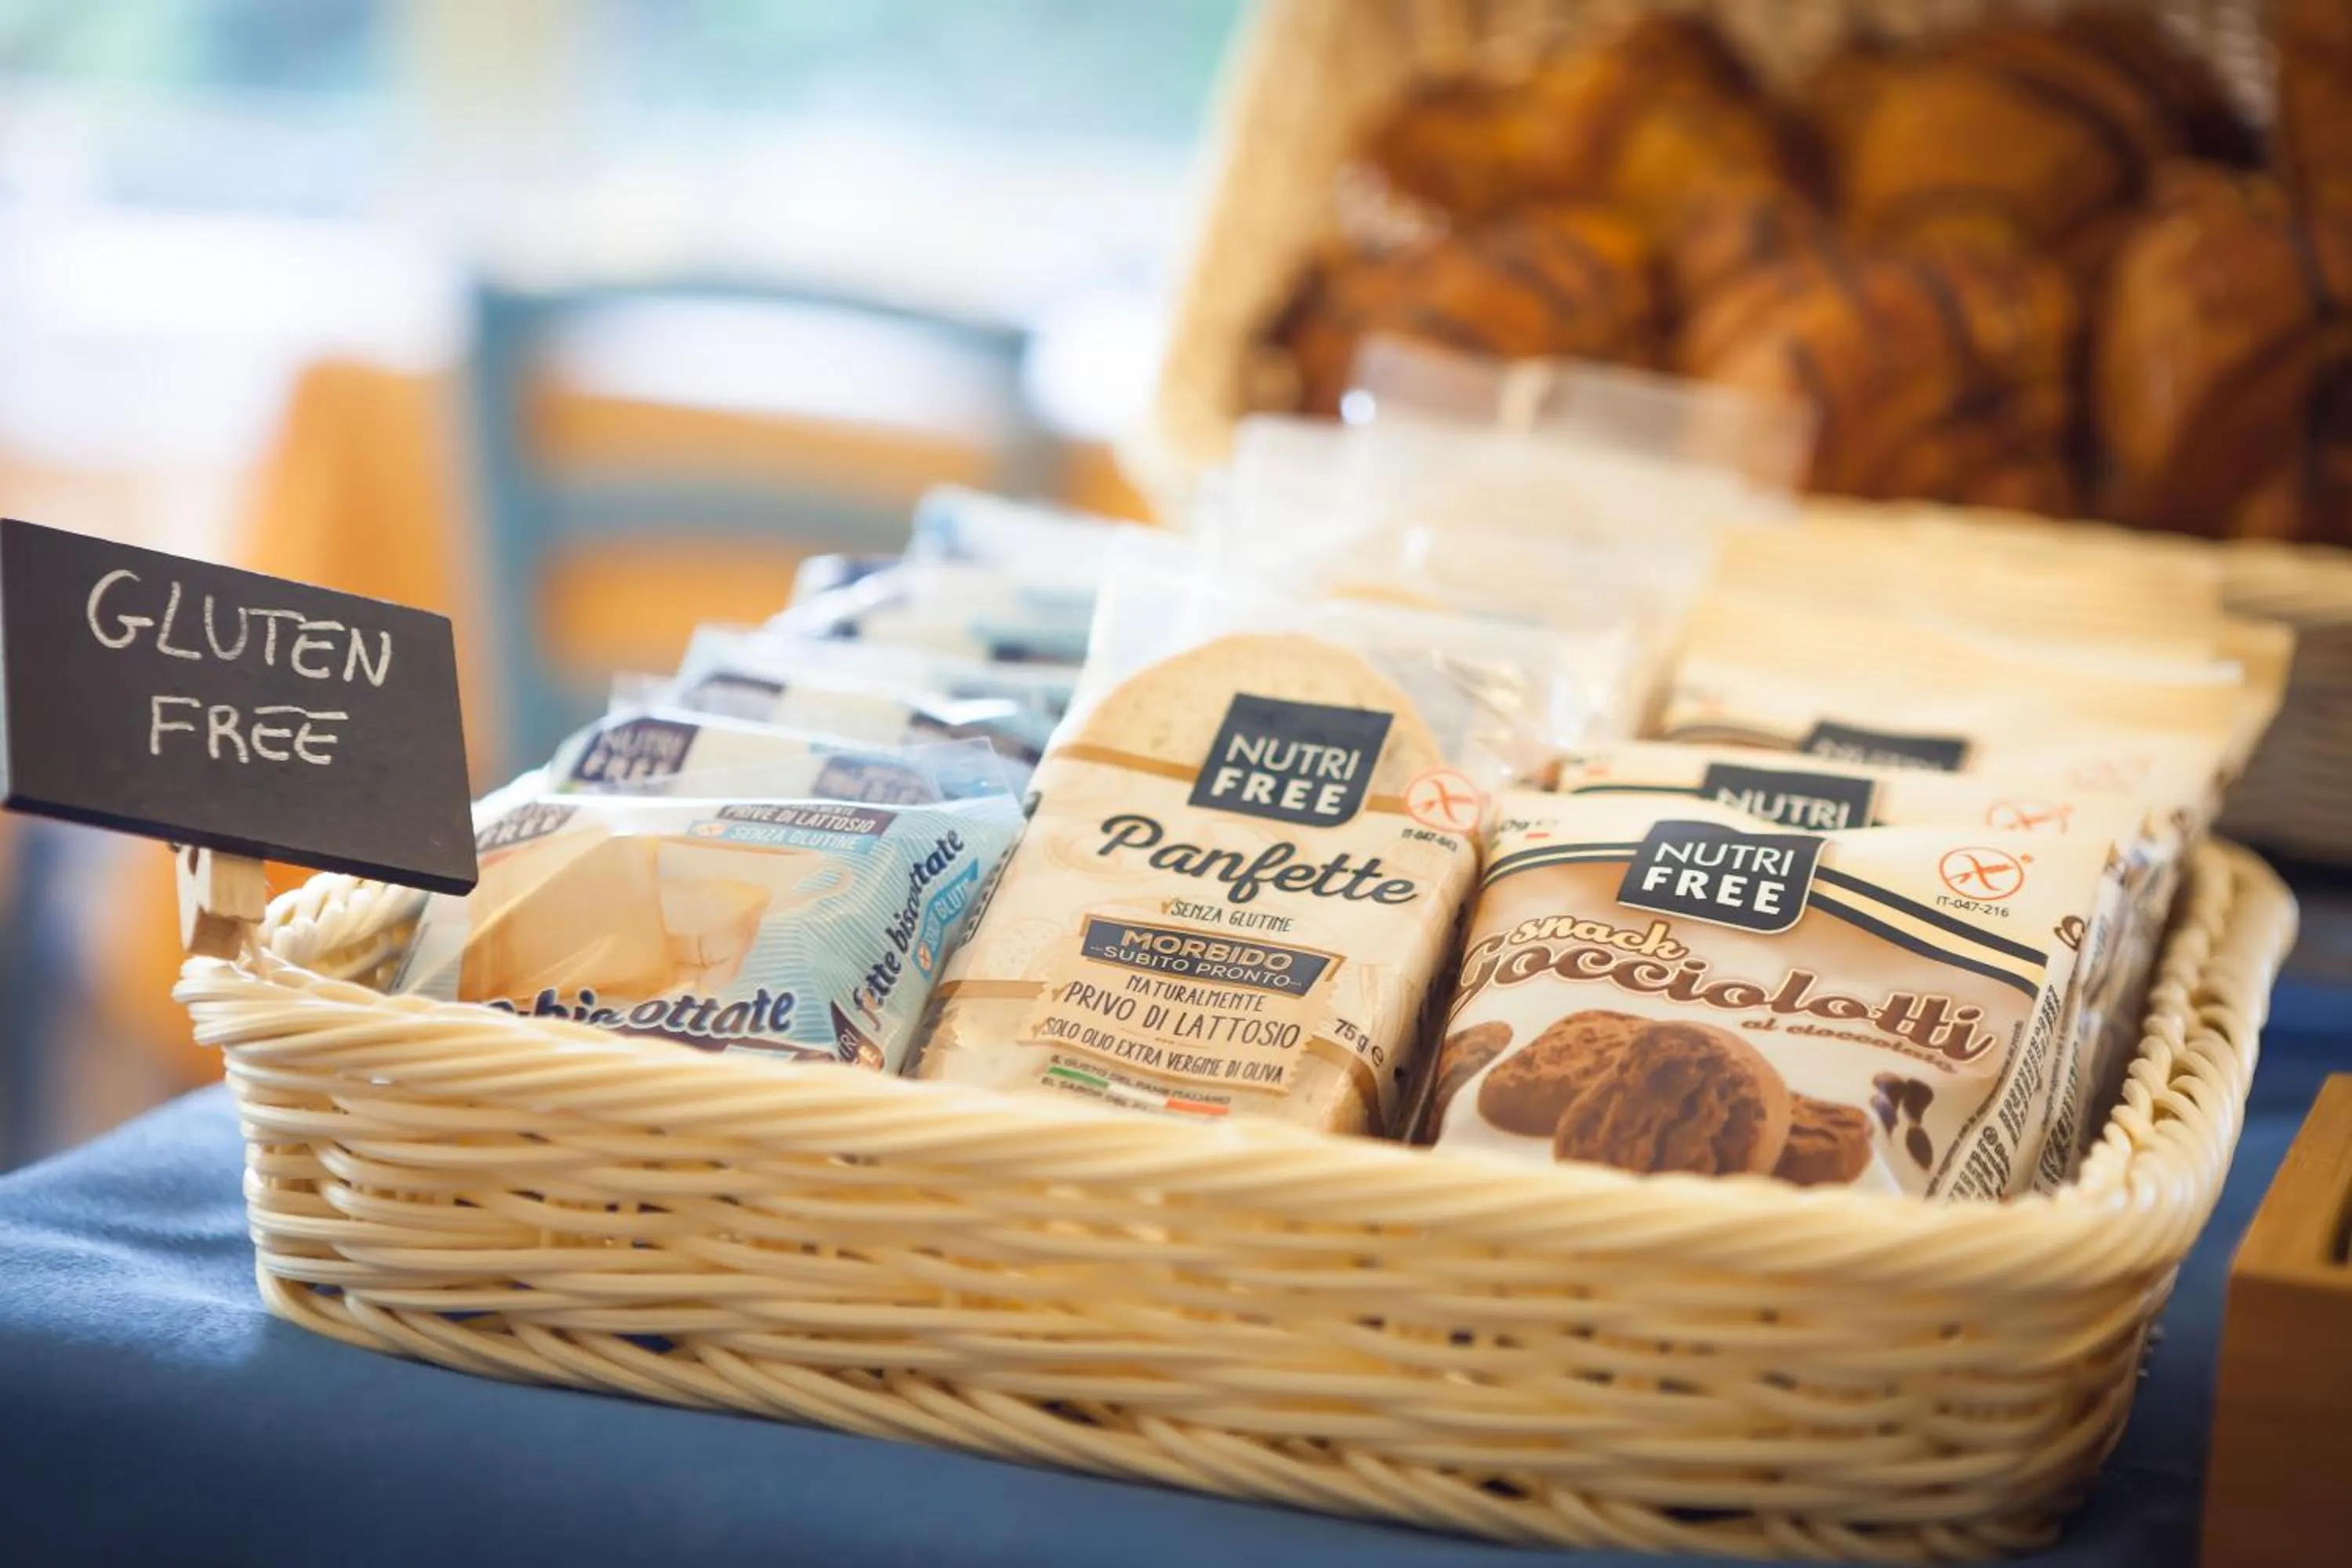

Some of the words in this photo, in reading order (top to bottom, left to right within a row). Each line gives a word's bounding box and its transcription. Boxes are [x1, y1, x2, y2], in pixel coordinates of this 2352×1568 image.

[86, 569, 391, 686] GLUTEN
[150, 695, 349, 764] FREE
[1225, 733, 1361, 781] NUTRI
[1210, 767, 1347, 815] FREE
[1715, 788, 1850, 830] NUTRI
[775, 809, 798, 824] DI
[795, 812, 876, 833] LATTOSIO
[1097, 815, 1418, 904] Panfette
[1653, 841, 1795, 877] NUTRI
[1642, 866, 1785, 915] FREE
[1936, 895, 2010, 918] IT-047-216
[1171, 902, 1221, 924] SENZA
[1229, 911, 1294, 932] GLUTINE
[1511, 916, 1690, 960] snack
[1103, 946, 1189, 971] SUBITO
[1196, 964, 1290, 988] PRONTO
[1121, 930, 1293, 971] MORBIDO
[854, 951, 902, 1032] fette
[1125, 975, 1268, 1012] NATURALMENTE
[1450, 931, 1996, 1063] Gocciolotti
[1064, 981, 1136, 1022] PRIVO
[1142, 1005, 1168, 1031] DI
[1174, 1012, 1301, 1049] LATTOSIO
[1741, 1017, 1778, 1032] al
[1042, 1017, 1080, 1040] SOLO
[1081, 1028, 1114, 1051] OLIO
[1115, 1039, 1160, 1066] EXTRA
[1166, 1051, 1226, 1078] VERGINE
[1225, 1062, 1239, 1079] DI
[1243, 1062, 1284, 1084] OLIVA
